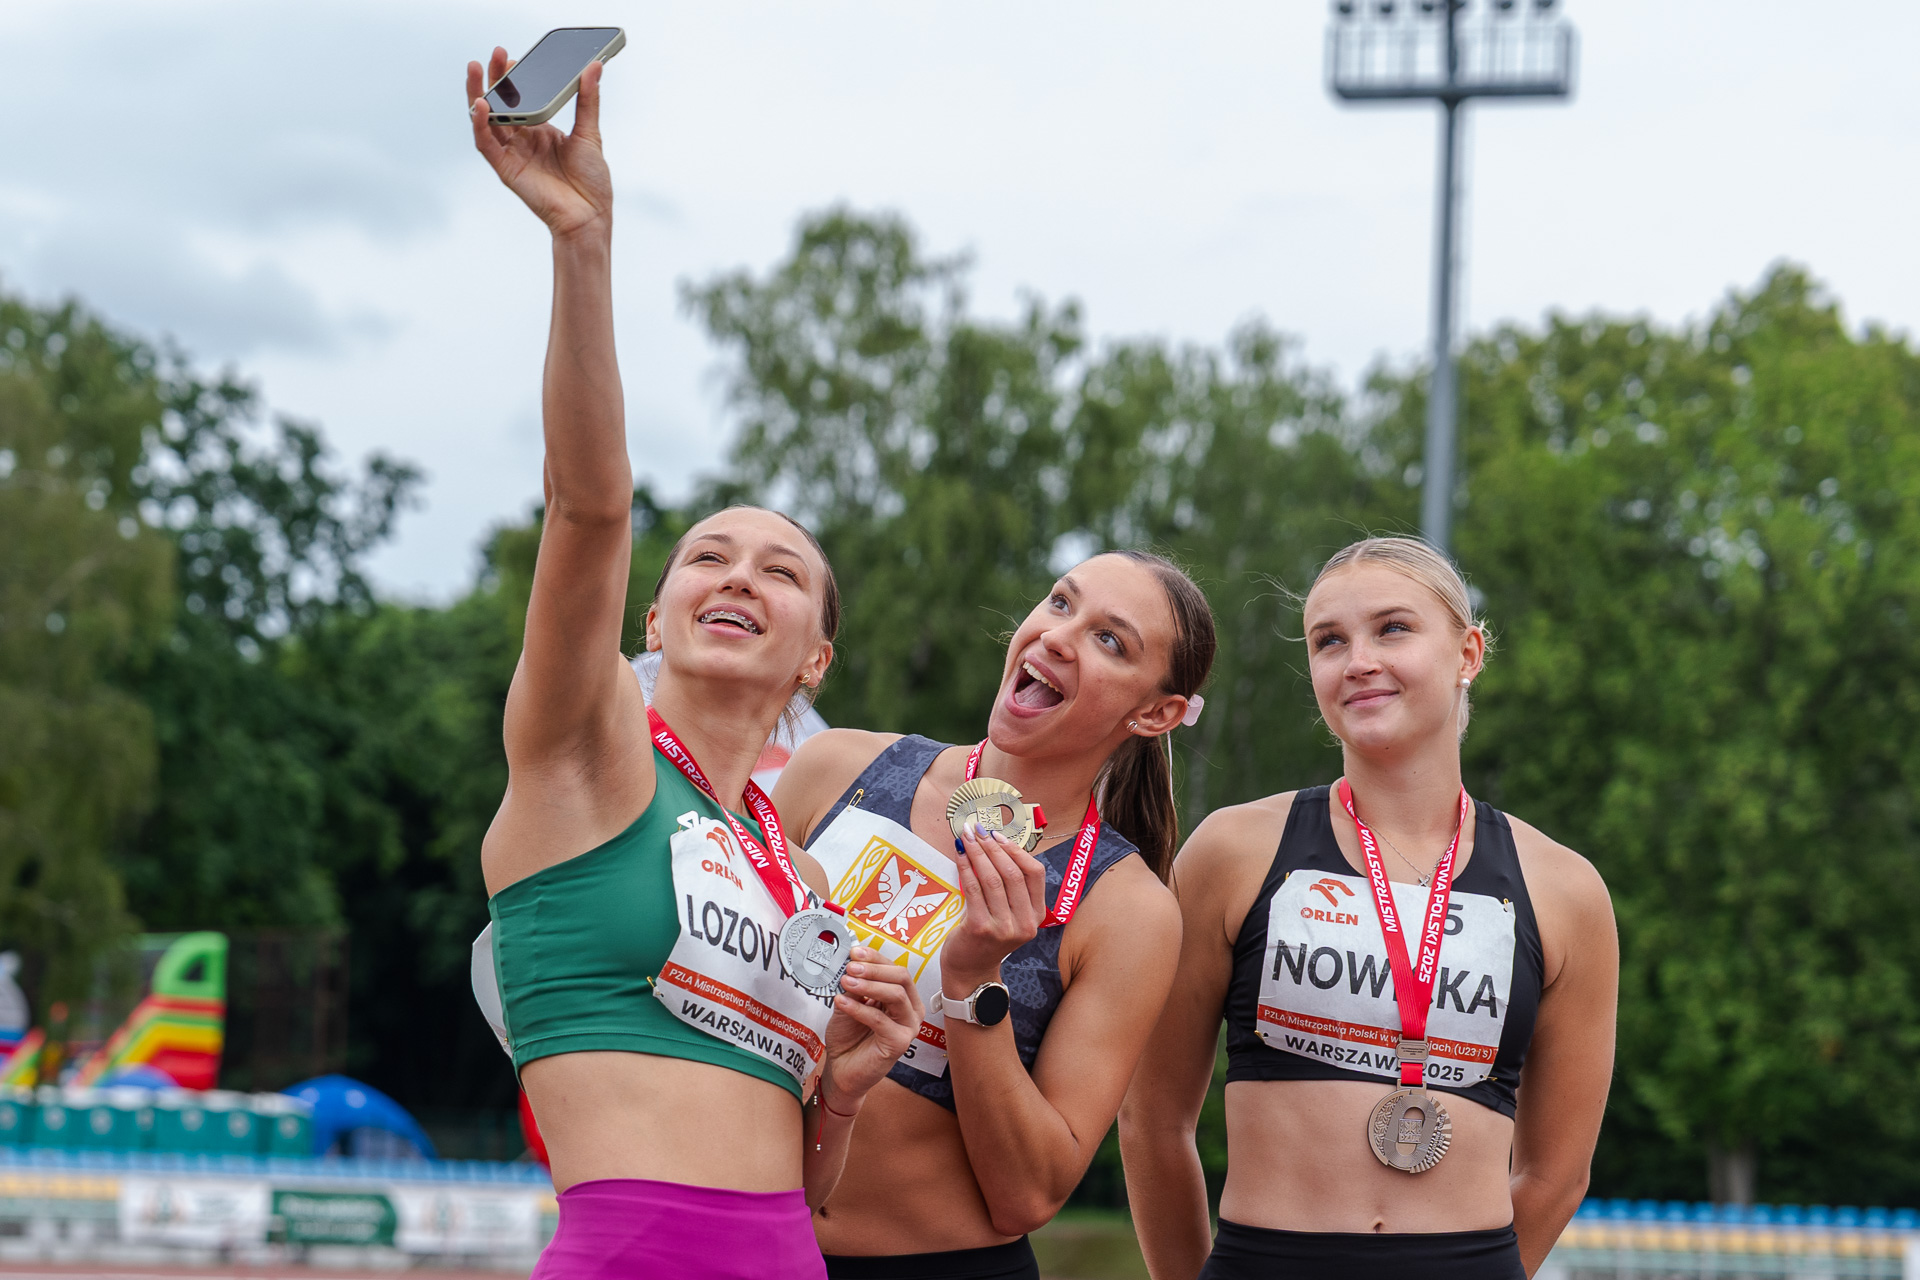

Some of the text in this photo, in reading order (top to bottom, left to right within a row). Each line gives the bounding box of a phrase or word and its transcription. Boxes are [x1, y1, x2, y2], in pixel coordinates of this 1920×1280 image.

[701, 859, 743, 891] ORLEN
[1361, 829, 1398, 932] MISTRZOSTWA
[1300, 907, 1359, 926] ORLEN
[1426, 893, 1444, 945] POLSKI
[668, 968, 693, 985] PZLA
[694, 978, 744, 1007] Mistrzostwa
[1272, 939, 1498, 1018] NOWKA
[1418, 947, 1436, 984] 2025
[681, 999, 783, 1060] WARSZAWA
[1264, 1009, 1286, 1021] PZLA
[1288, 1016, 1347, 1035] Mistrzostwa
[1348, 1027, 1378, 1040] Polski
[1454, 1043, 1476, 1056] (U23
[1285, 1034, 1465, 1082] WARSZAW 025
